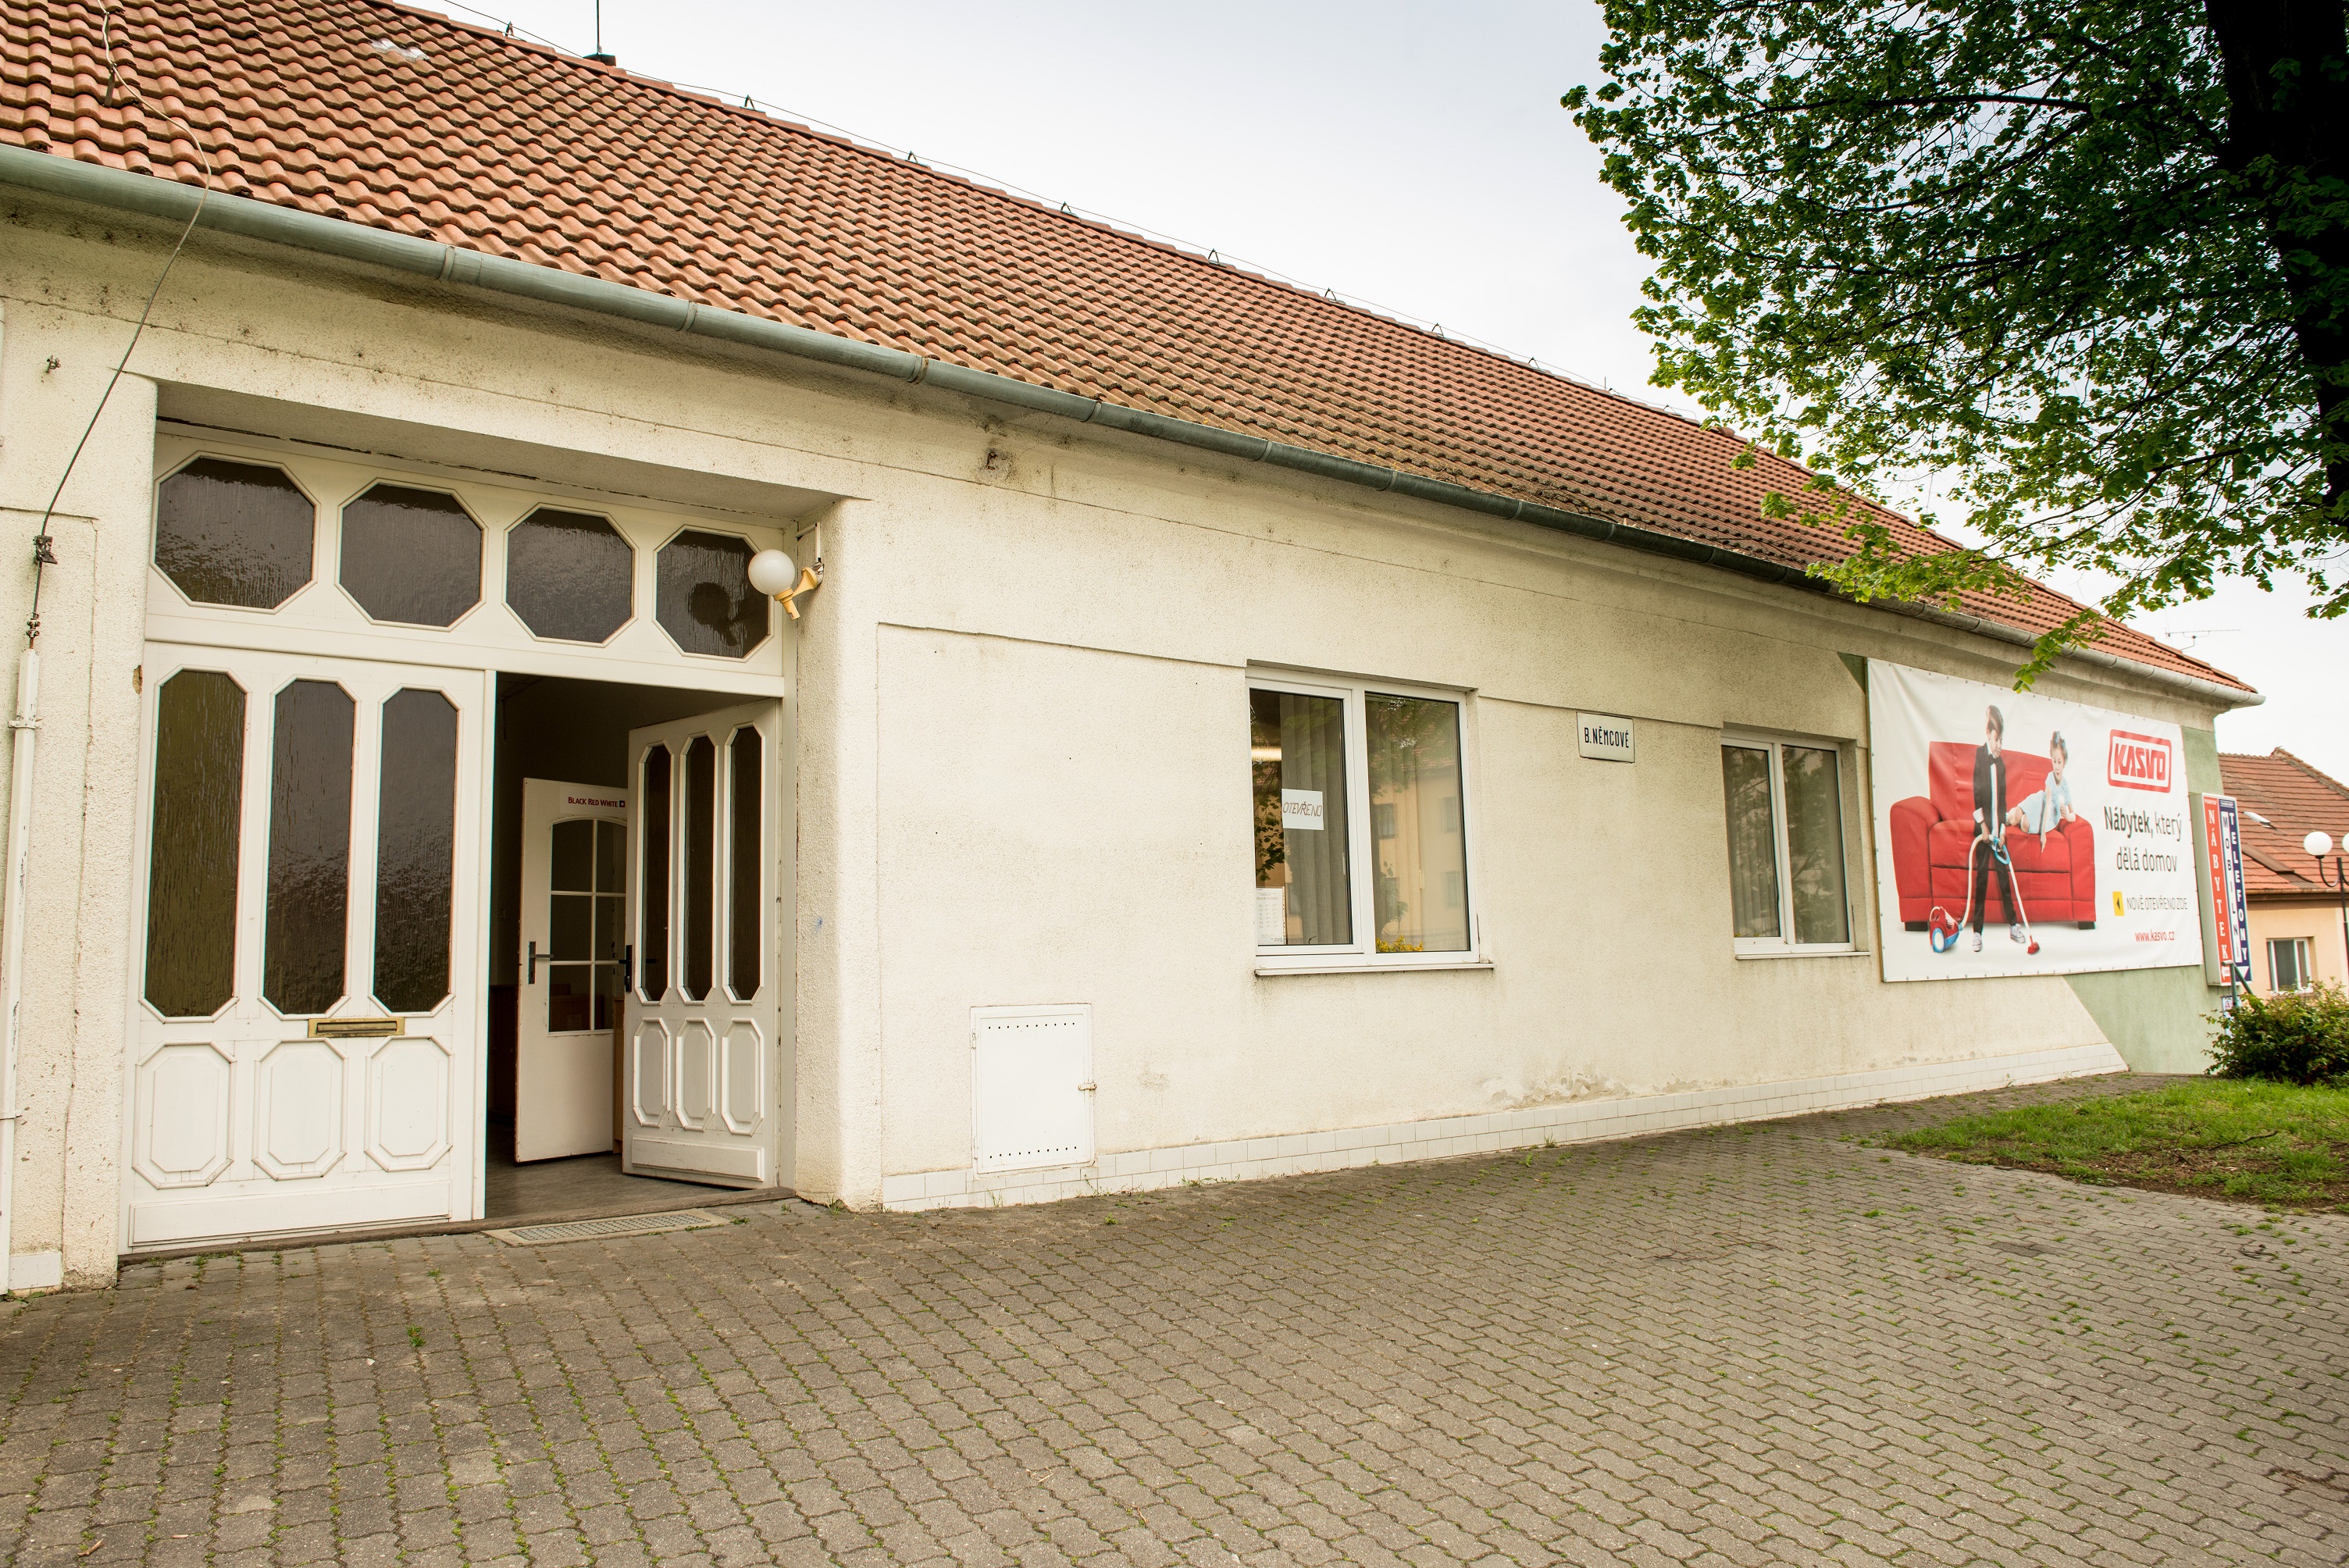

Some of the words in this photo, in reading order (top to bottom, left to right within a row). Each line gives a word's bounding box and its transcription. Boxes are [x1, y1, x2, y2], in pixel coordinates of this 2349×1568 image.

[2114, 743, 2166, 781] KASVO
[568, 796, 586, 805] BLACK
[601, 799, 618, 807] WHITE
[1282, 801, 1322, 817] OTEVŘENO
[2104, 806, 2153, 839] Nábytek,
[2155, 811, 2182, 842] který
[2116, 846, 2140, 871] dělá
[2142, 848, 2177, 872] domov
[2208, 809, 2229, 959] NÁBYTEK
[2229, 812, 2247, 960] TELEFONY
[2176, 897, 2187, 910] ZDE
[2134, 929, 2175, 942] www.kasvo.cz
